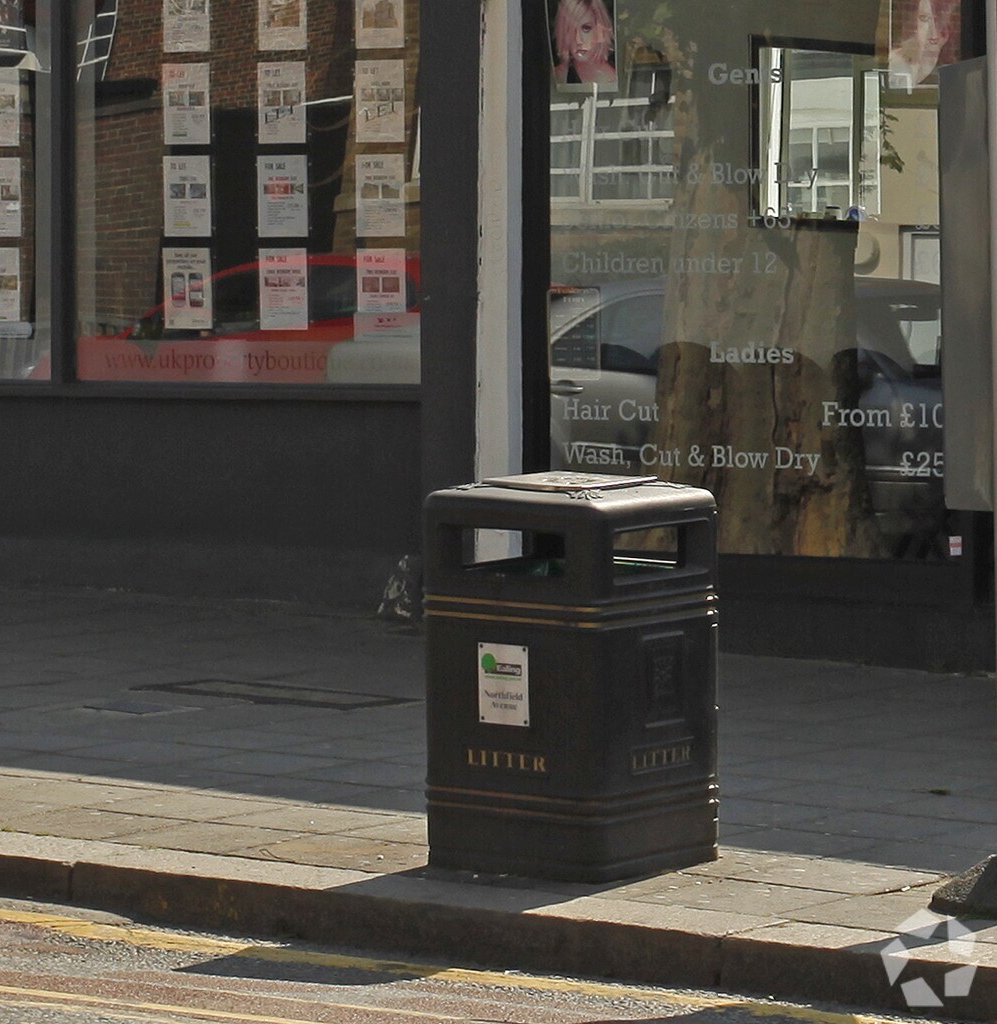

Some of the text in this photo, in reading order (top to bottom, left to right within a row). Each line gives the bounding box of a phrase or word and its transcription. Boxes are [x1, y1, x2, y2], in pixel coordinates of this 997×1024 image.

[707, 63, 783, 86] Gens
[710, 163, 764, 185] Blow
[562, 252, 777, 275] Children under 12
[708, 341, 794, 367] Ladies
[562, 399, 611, 425] Hair
[618, 401, 660, 425] Cut
[822, 401, 891, 431] From
[562, 443, 943, 480] Wash, Cut & Blow Dry £25
[467, 745, 692, 773] LITTER LITTER
